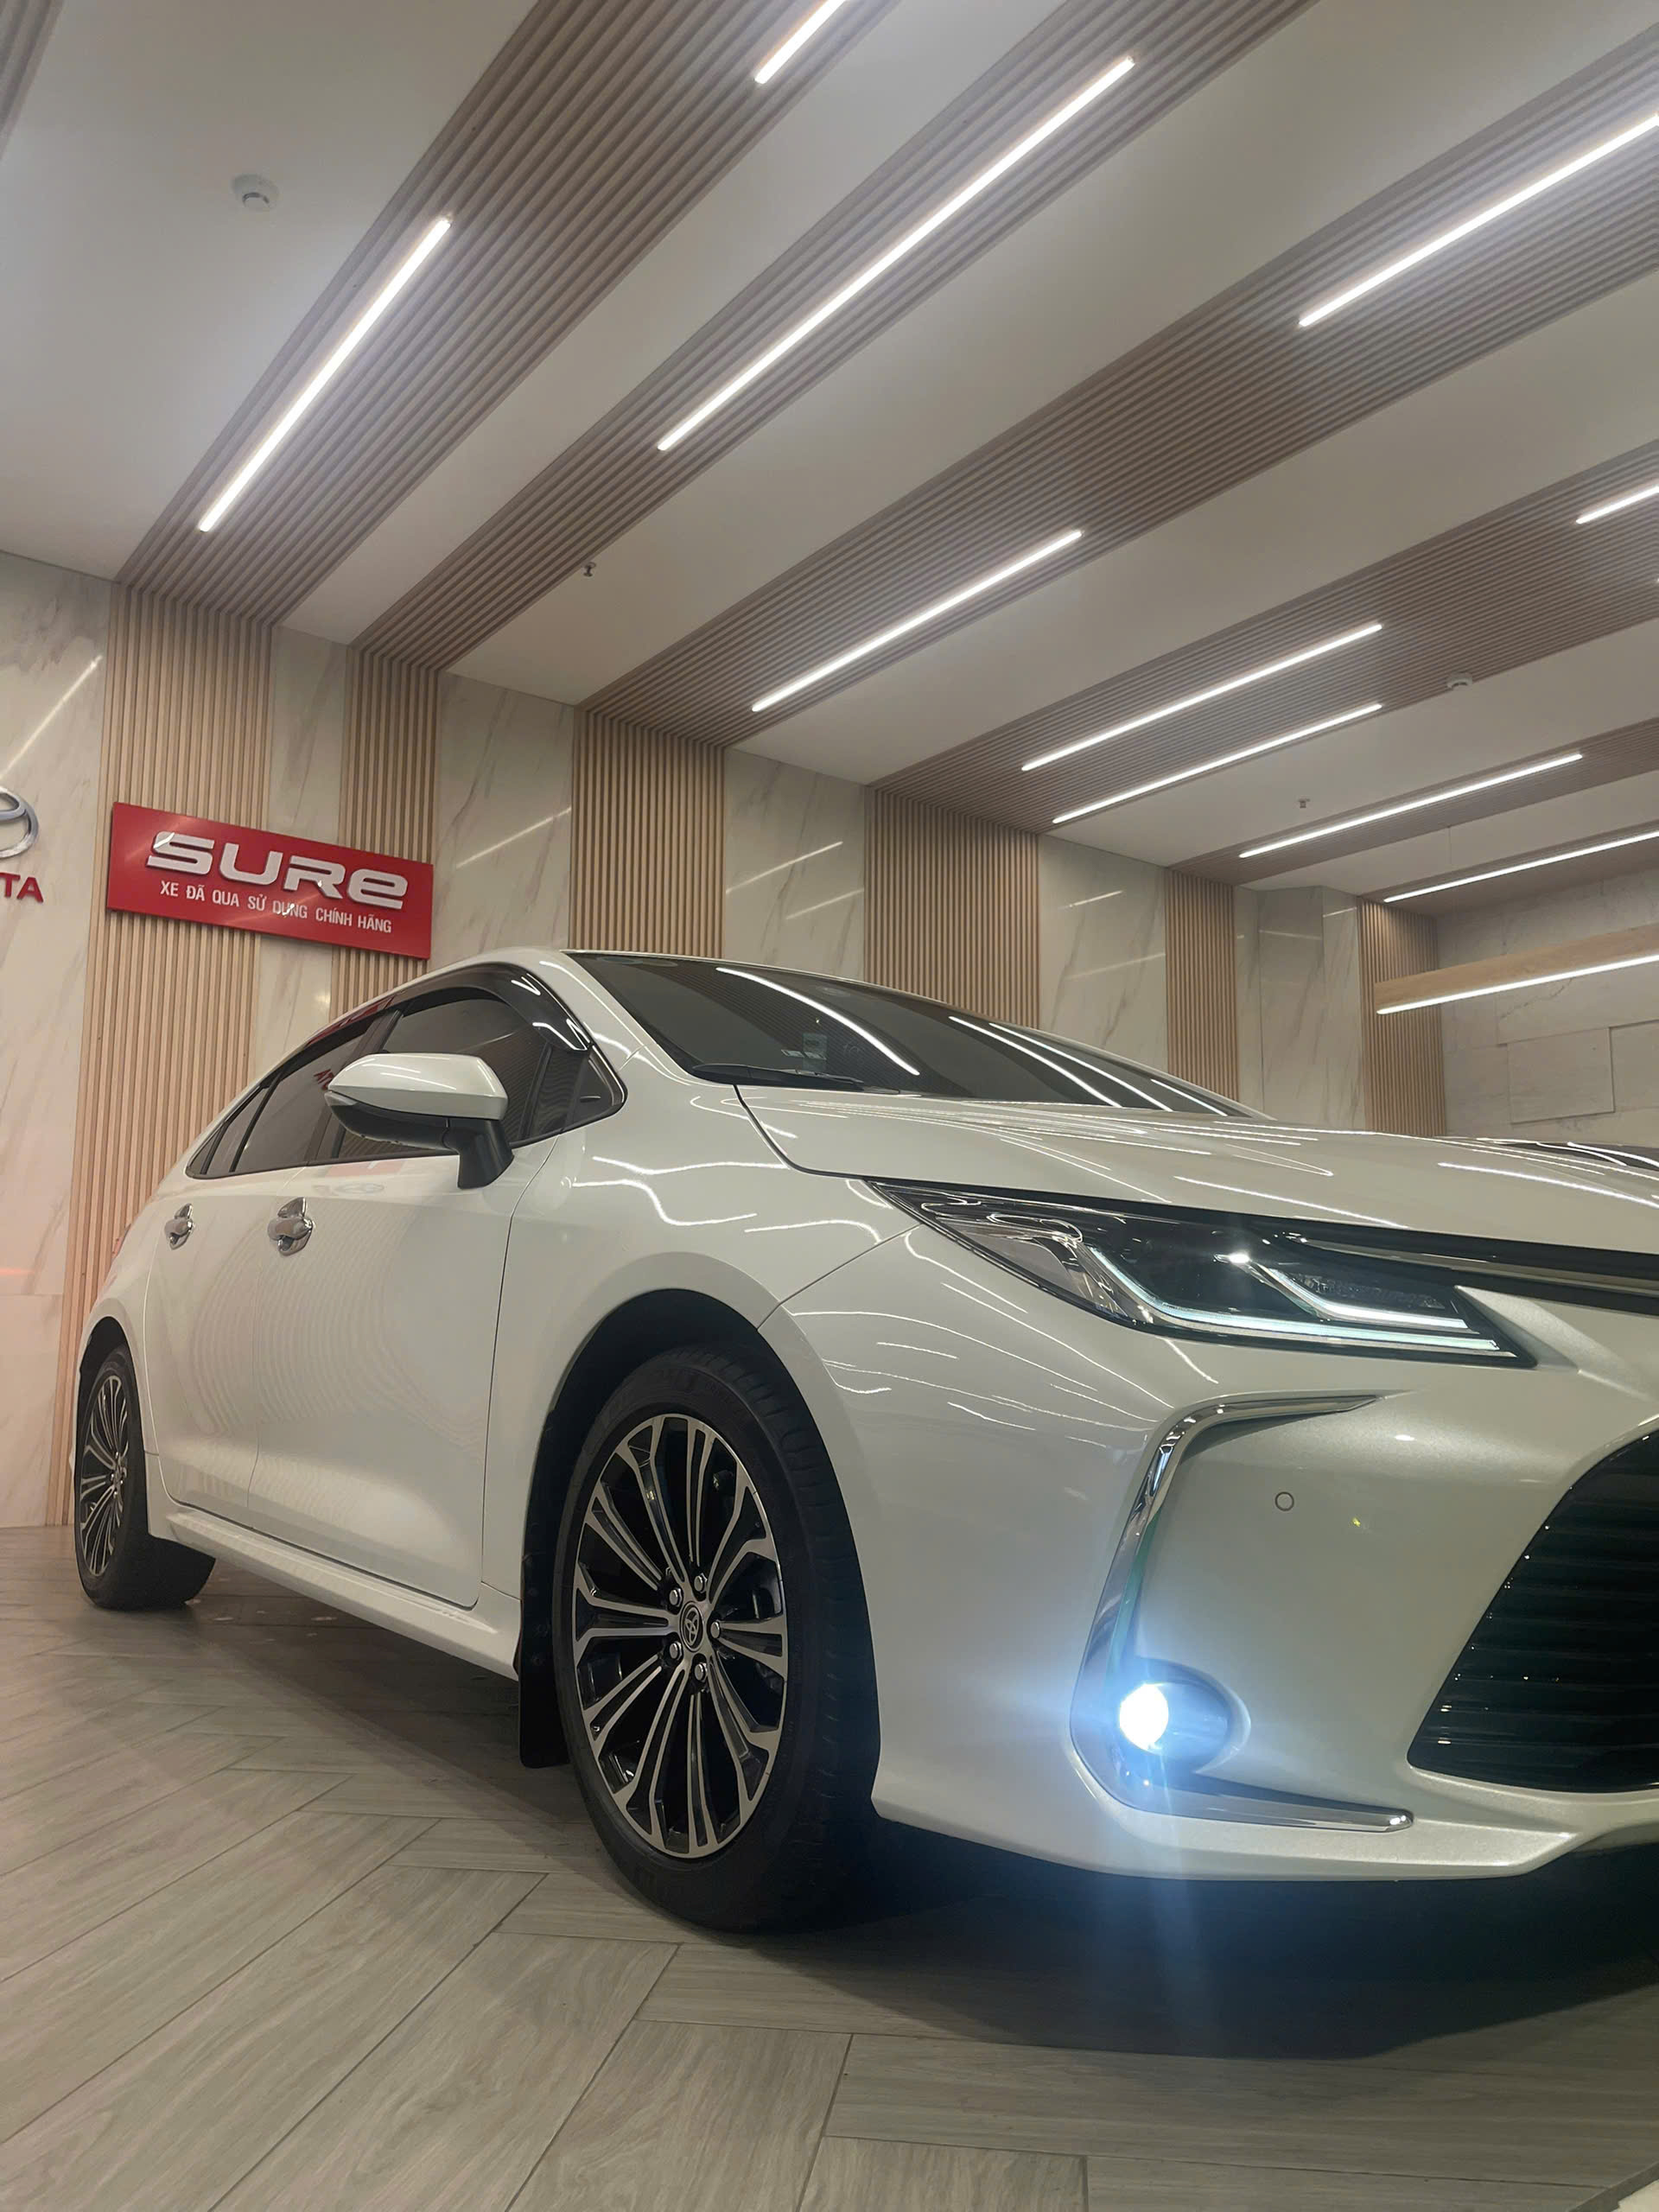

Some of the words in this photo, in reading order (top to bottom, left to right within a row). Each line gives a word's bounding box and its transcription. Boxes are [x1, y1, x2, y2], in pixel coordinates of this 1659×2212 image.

[160, 880, 179, 897] XE
[186, 885, 206, 901] ĐÃ
[212, 889, 240, 907] QUA
[247, 893, 267, 912] SỬ
[272, 900, 308, 918] DỤNG
[315, 907, 353, 926] CHÍNH
[358, 913, 391, 933] HÃNG
